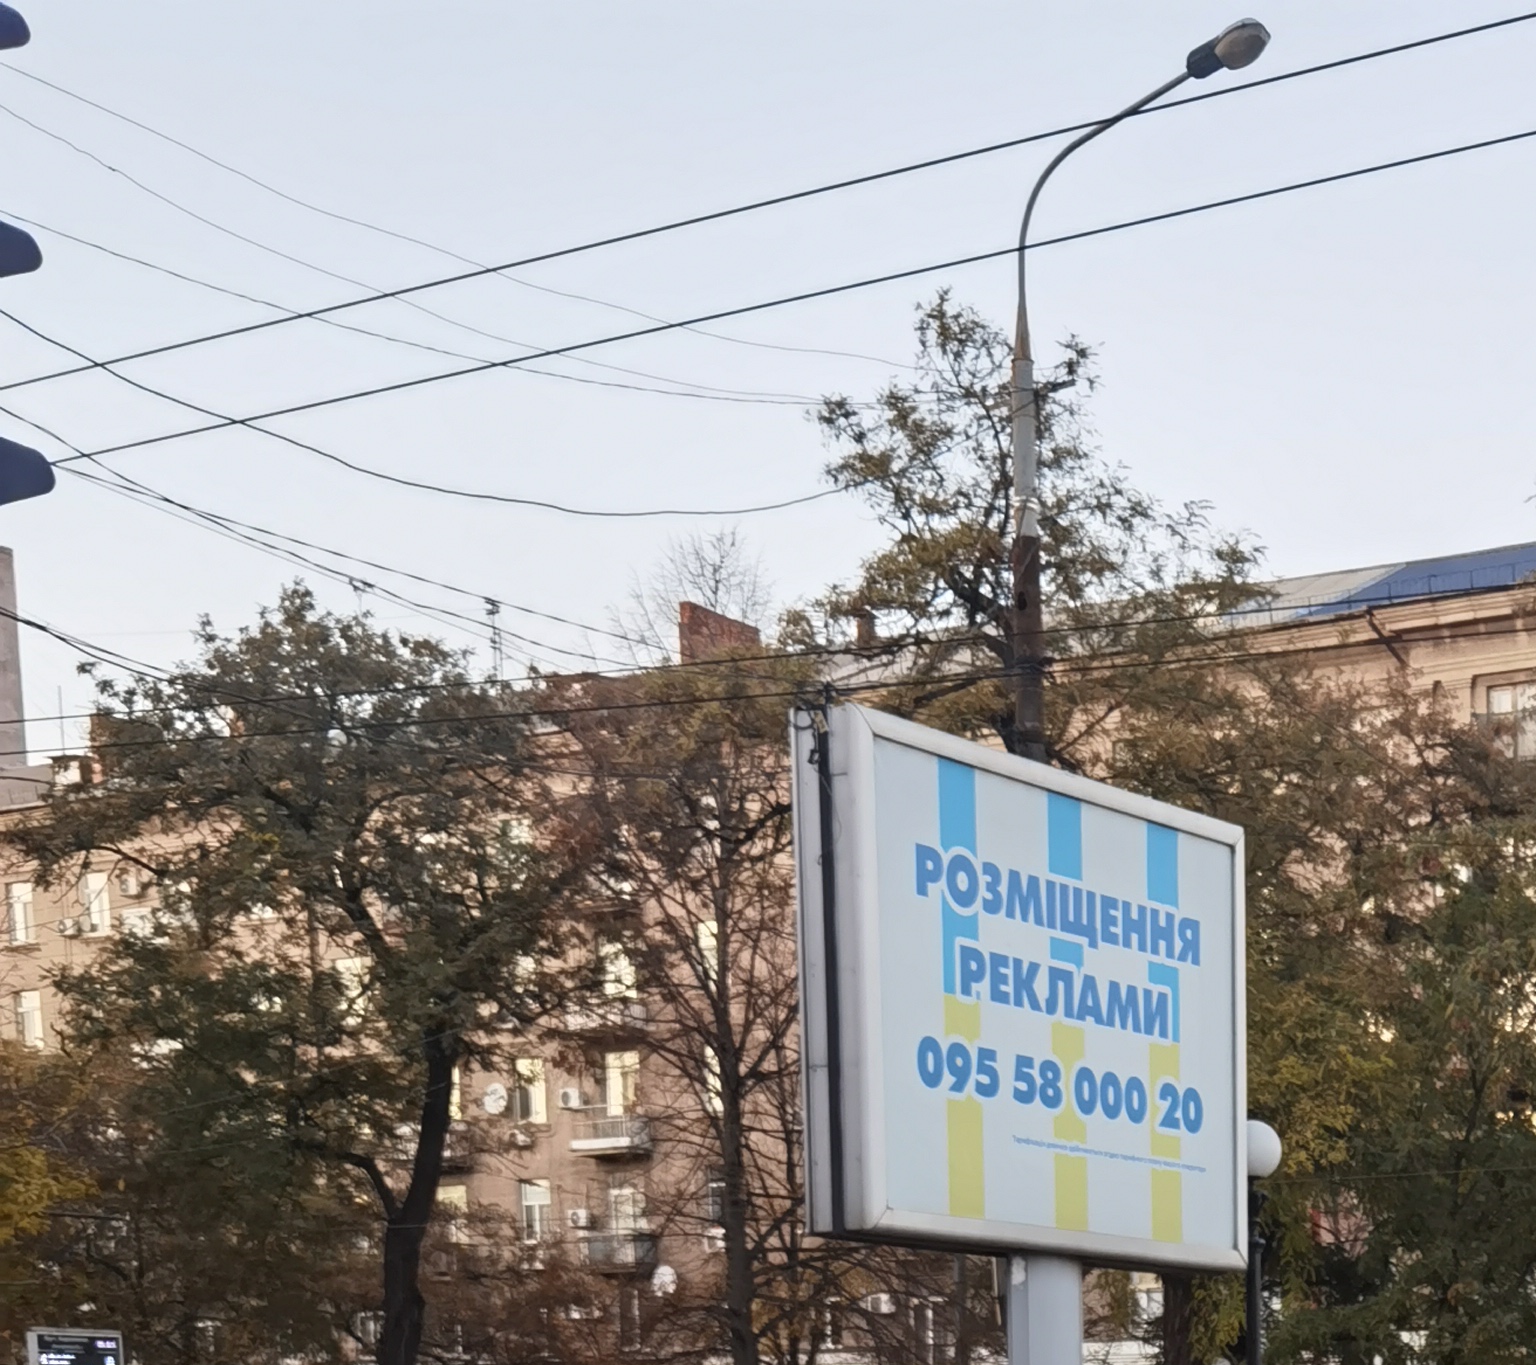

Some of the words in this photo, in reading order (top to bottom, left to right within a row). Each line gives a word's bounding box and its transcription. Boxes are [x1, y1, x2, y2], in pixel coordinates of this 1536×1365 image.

[915, 843, 1200, 967] РОЗМІЩЕННЯ
[959, 944, 1169, 1040] РЕКЛАМИ
[917, 1036, 999, 1099] 095
[1013, 1054, 1062, 1109] 58
[1074, 1067, 1146, 1125] 000
[1159, 1083, 1203, 1134] 20
